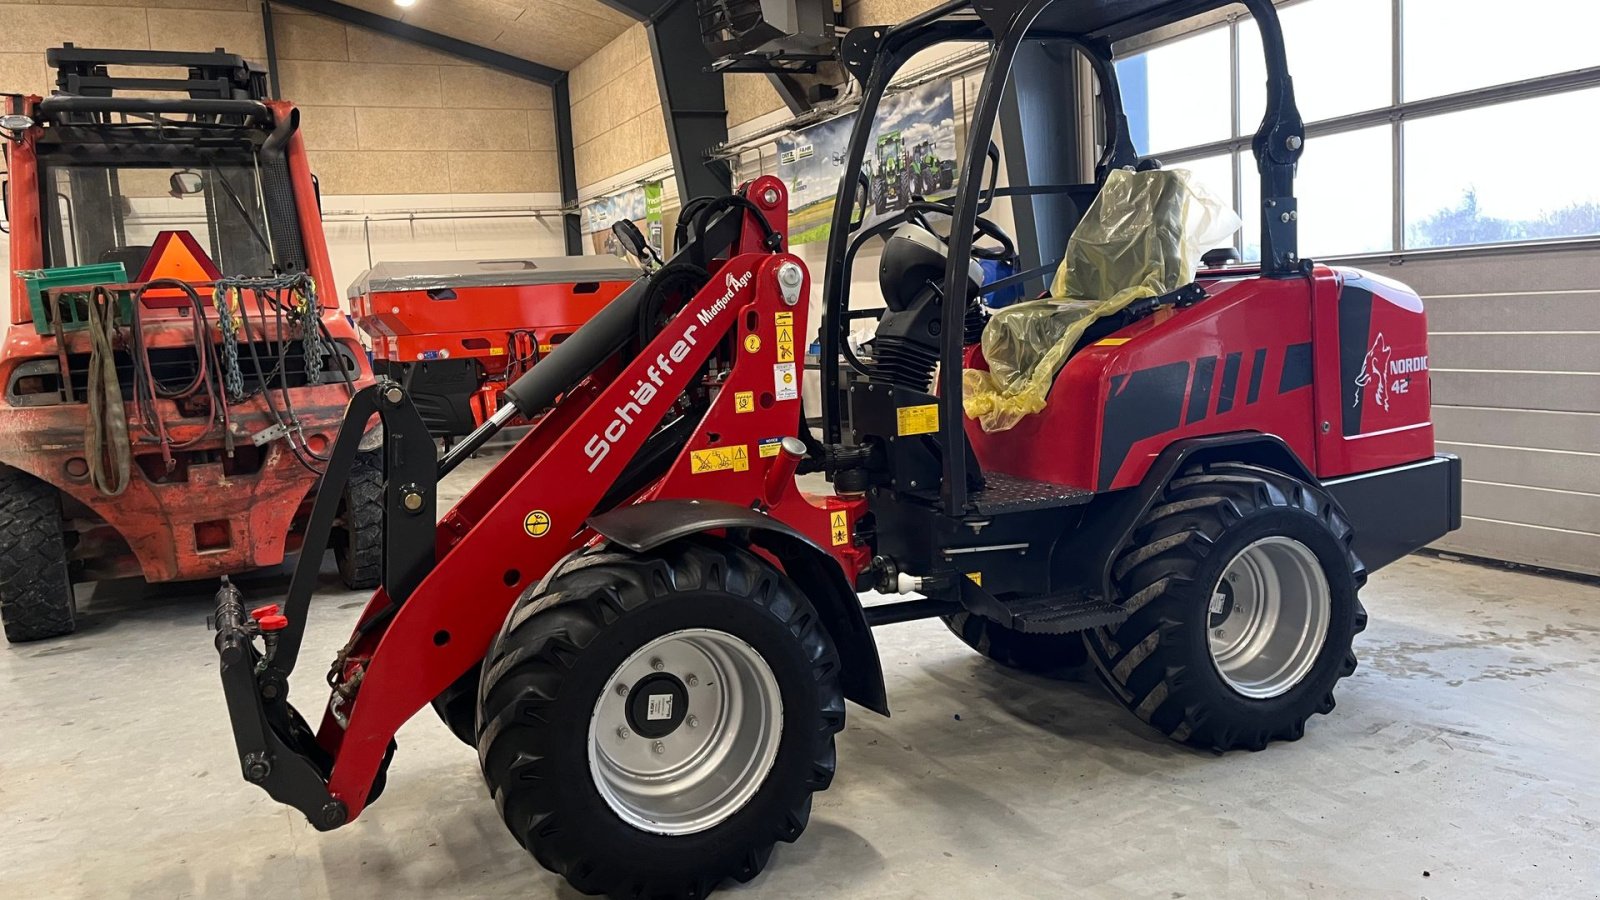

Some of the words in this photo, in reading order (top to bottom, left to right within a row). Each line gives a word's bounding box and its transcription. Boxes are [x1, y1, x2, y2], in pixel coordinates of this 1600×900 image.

[584, 324, 698, 473] Schäffer
[696, 287, 735, 327] Midtfjord
[729, 270, 753, 292] Agro
[1390, 355, 1428, 375] NORDIC
[1391, 379, 1409, 394] 42
